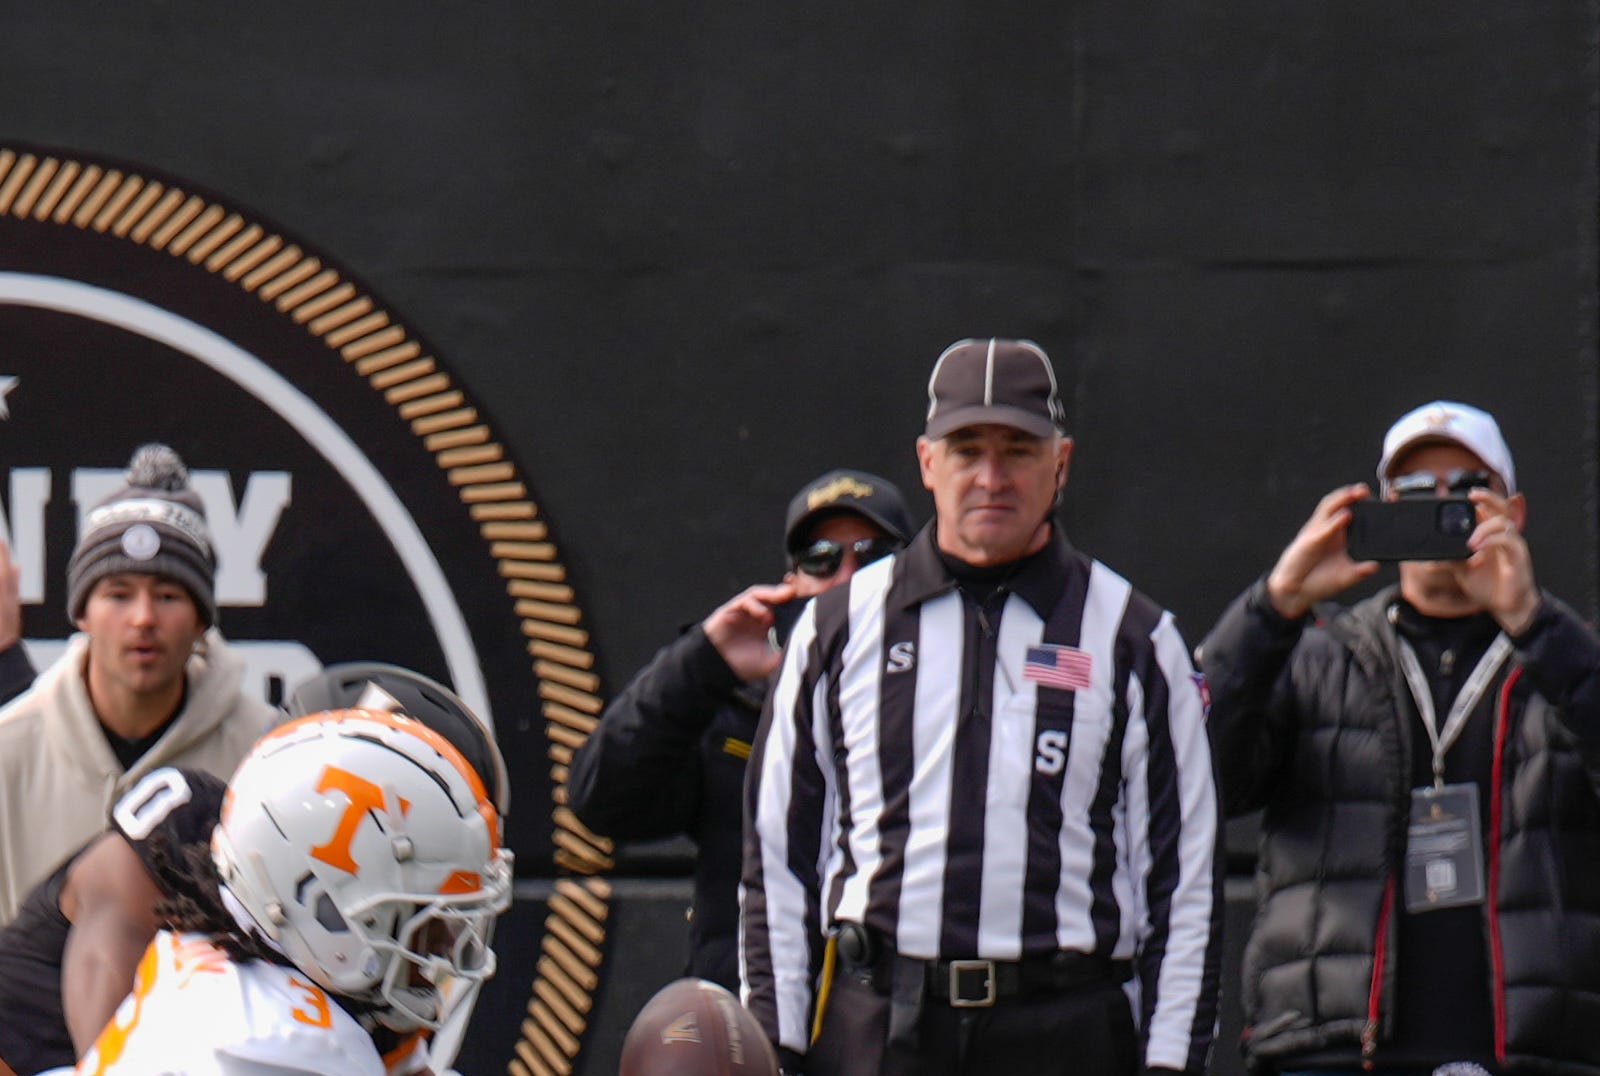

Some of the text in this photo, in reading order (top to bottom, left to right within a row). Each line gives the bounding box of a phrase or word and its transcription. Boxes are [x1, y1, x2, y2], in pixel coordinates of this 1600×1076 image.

[886, 642, 914, 673] S
[1035, 729, 1068, 775] S
[309, 763, 412, 878] T
[289, 976, 333, 1030] 3
